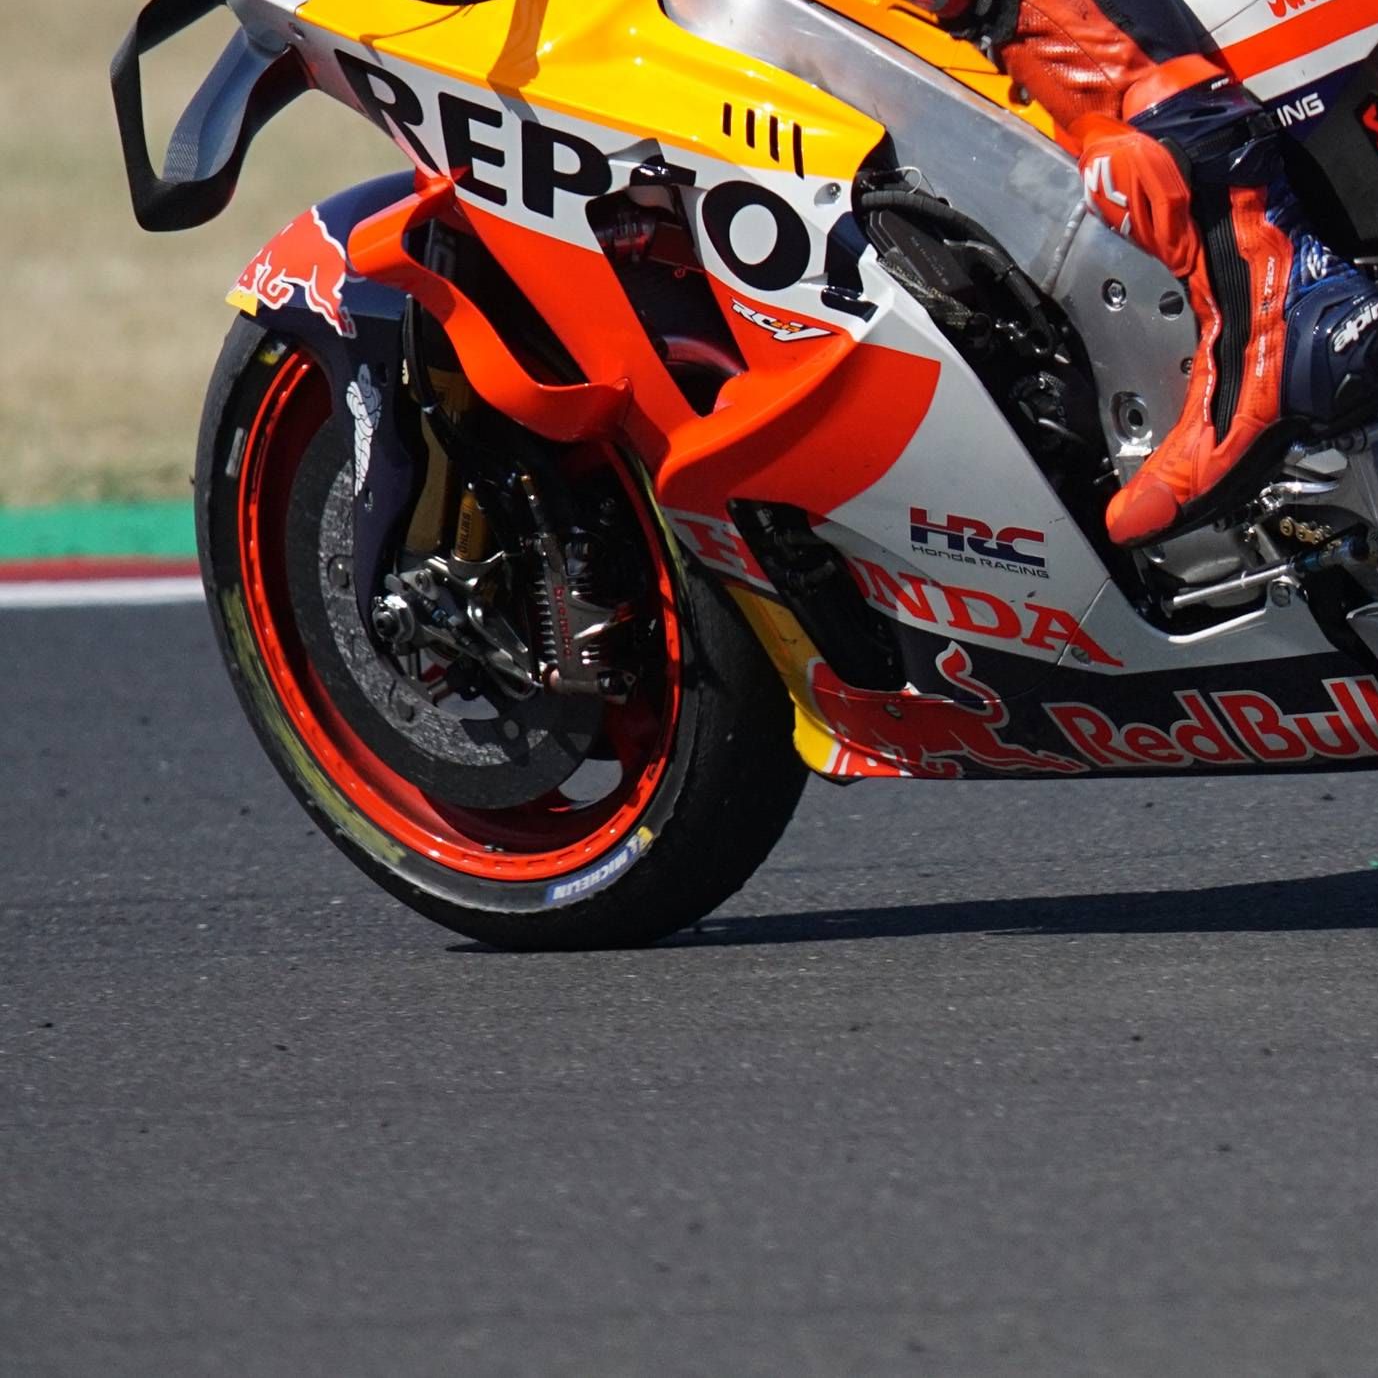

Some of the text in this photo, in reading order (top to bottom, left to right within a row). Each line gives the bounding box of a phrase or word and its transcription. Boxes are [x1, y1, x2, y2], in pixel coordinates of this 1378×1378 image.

[333, 48, 879, 322] REPOL
[910, 506, 1045, 567] HRC
[911, 544, 1050, 579] Honda RACING
[673, 516, 1125, 669] HNDA
